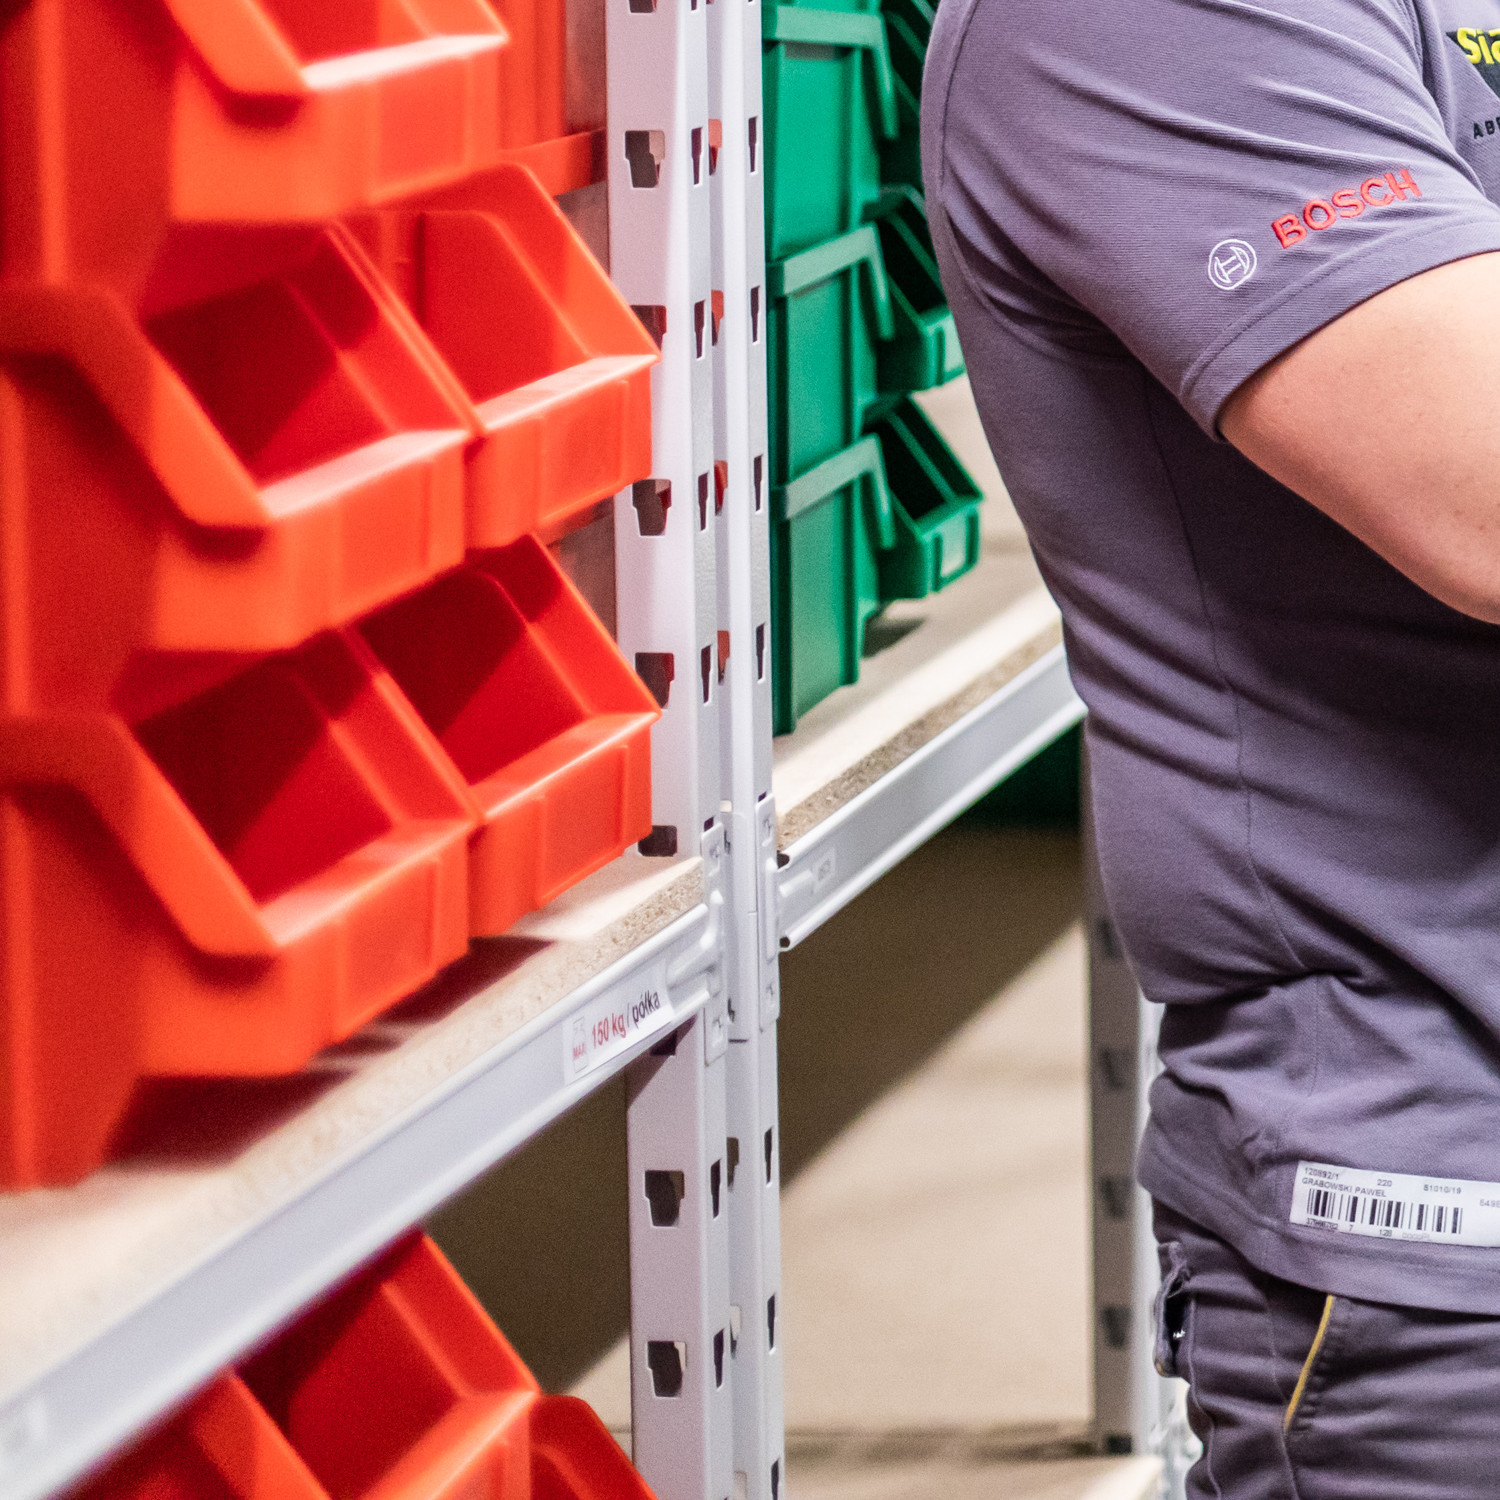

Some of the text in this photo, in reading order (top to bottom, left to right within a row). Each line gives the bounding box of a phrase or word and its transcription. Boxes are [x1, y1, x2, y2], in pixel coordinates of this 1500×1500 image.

[1271, 169, 1422, 249] BOSCH
[592, 1017, 609, 1049] 150
[611, 1012, 626, 1039] kg
[632, 990, 660, 1030] półka
[1301, 1177, 1353, 1193] GRABOWSKI
